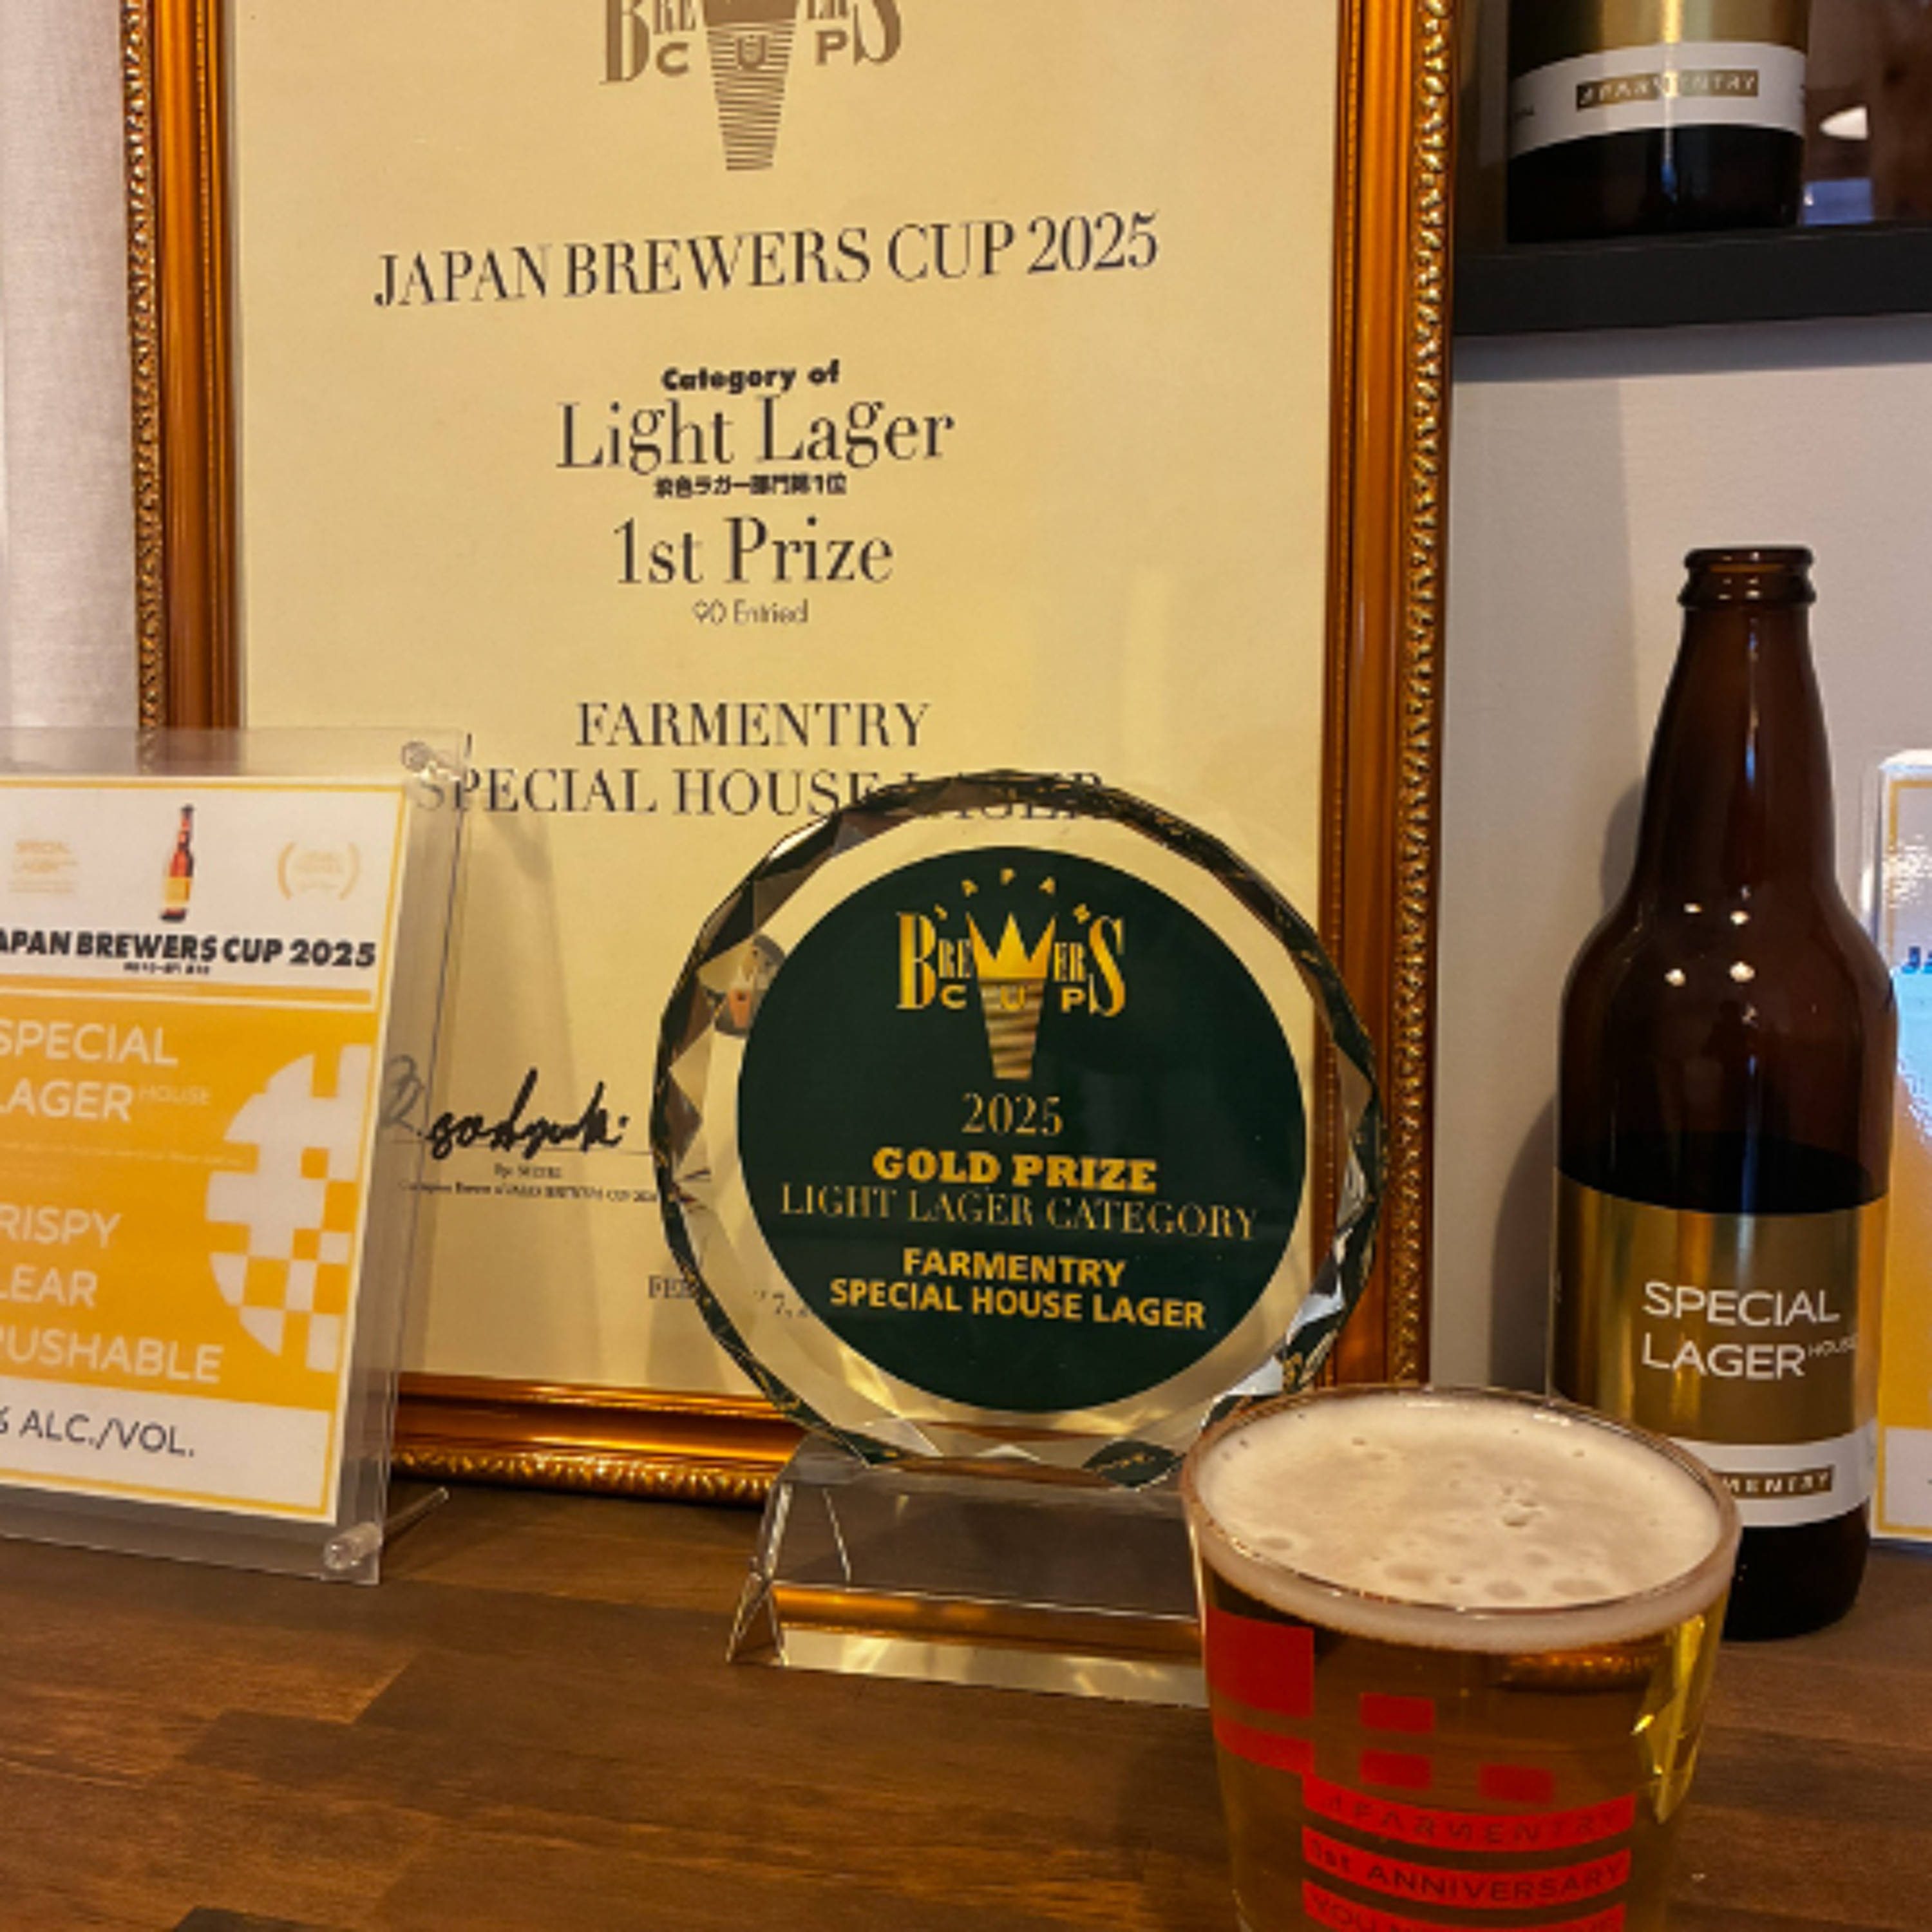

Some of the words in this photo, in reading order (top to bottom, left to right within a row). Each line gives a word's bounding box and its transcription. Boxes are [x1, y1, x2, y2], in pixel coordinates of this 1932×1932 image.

[374, 243, 551, 307] JAPAN
[563, 227, 871, 298] BREWERS
[888, 220, 1015, 282] CUP
[1027, 208, 1159, 275] 2025
[661, 366, 797, 394] Category
[808, 359, 840, 386] of
[557, 399, 735, 475] Light
[757, 395, 955, 468] Lager
[613, 517, 704, 584] 1st
[723, 516, 894, 582] Prize
[692, 599, 727, 625] 90
[575, 702, 931, 747] FARMENTRY
[416, 768, 658, 813] SPECIAL
[75, 931, 218, 962] BREWERS
[223, 937, 283, 963] CUP
[289, 940, 376, 968] 2025
[0, 1077, 133, 1122] AGER
[961, 1093, 1064, 1136] 2025
[873, 1147, 1001, 1185] GOLD
[1012, 1154, 1158, 1194] PRIZE
[780, 1184, 898, 1219] LIGHT
[908, 1189, 1033, 1227] LAGER
[1046, 1197, 1259, 1241] CATEGORY
[903, 1247, 1127, 1287] FARMENTRY
[829, 1278, 962, 1312] SPECIAL
[972, 1285, 1083, 1322] HOUSE
[1093, 1293, 1206, 1330] LAGER
[1642, 1280, 1841, 1327] SPECIAL
[0, 1325, 224, 1385] USHABLE
[1642, 1331, 1806, 1380] LAGER
[19, 1408, 195, 1458] ALC./VOL.
[1367, 1860, 1624, 1902] ANNIVERSARY
